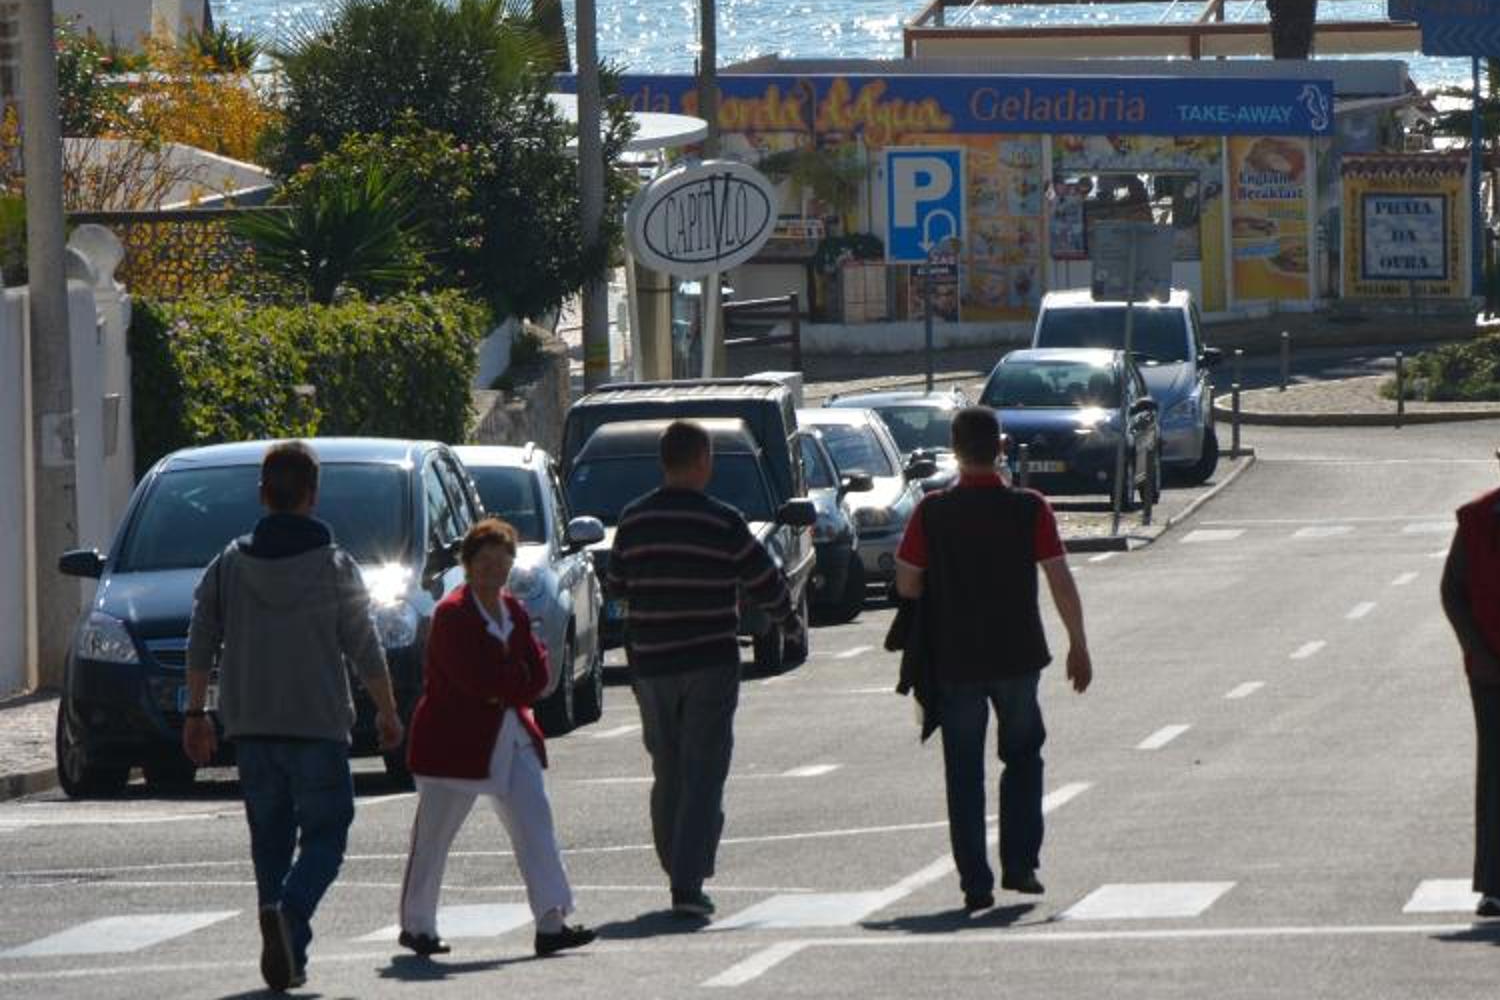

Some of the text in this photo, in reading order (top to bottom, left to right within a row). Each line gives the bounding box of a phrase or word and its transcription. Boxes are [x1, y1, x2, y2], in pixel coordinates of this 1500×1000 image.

[970, 86, 1145, 121] Geladaria
[1178, 104, 1294, 123] TAKE-AWAY
[894, 157, 953, 227] P
